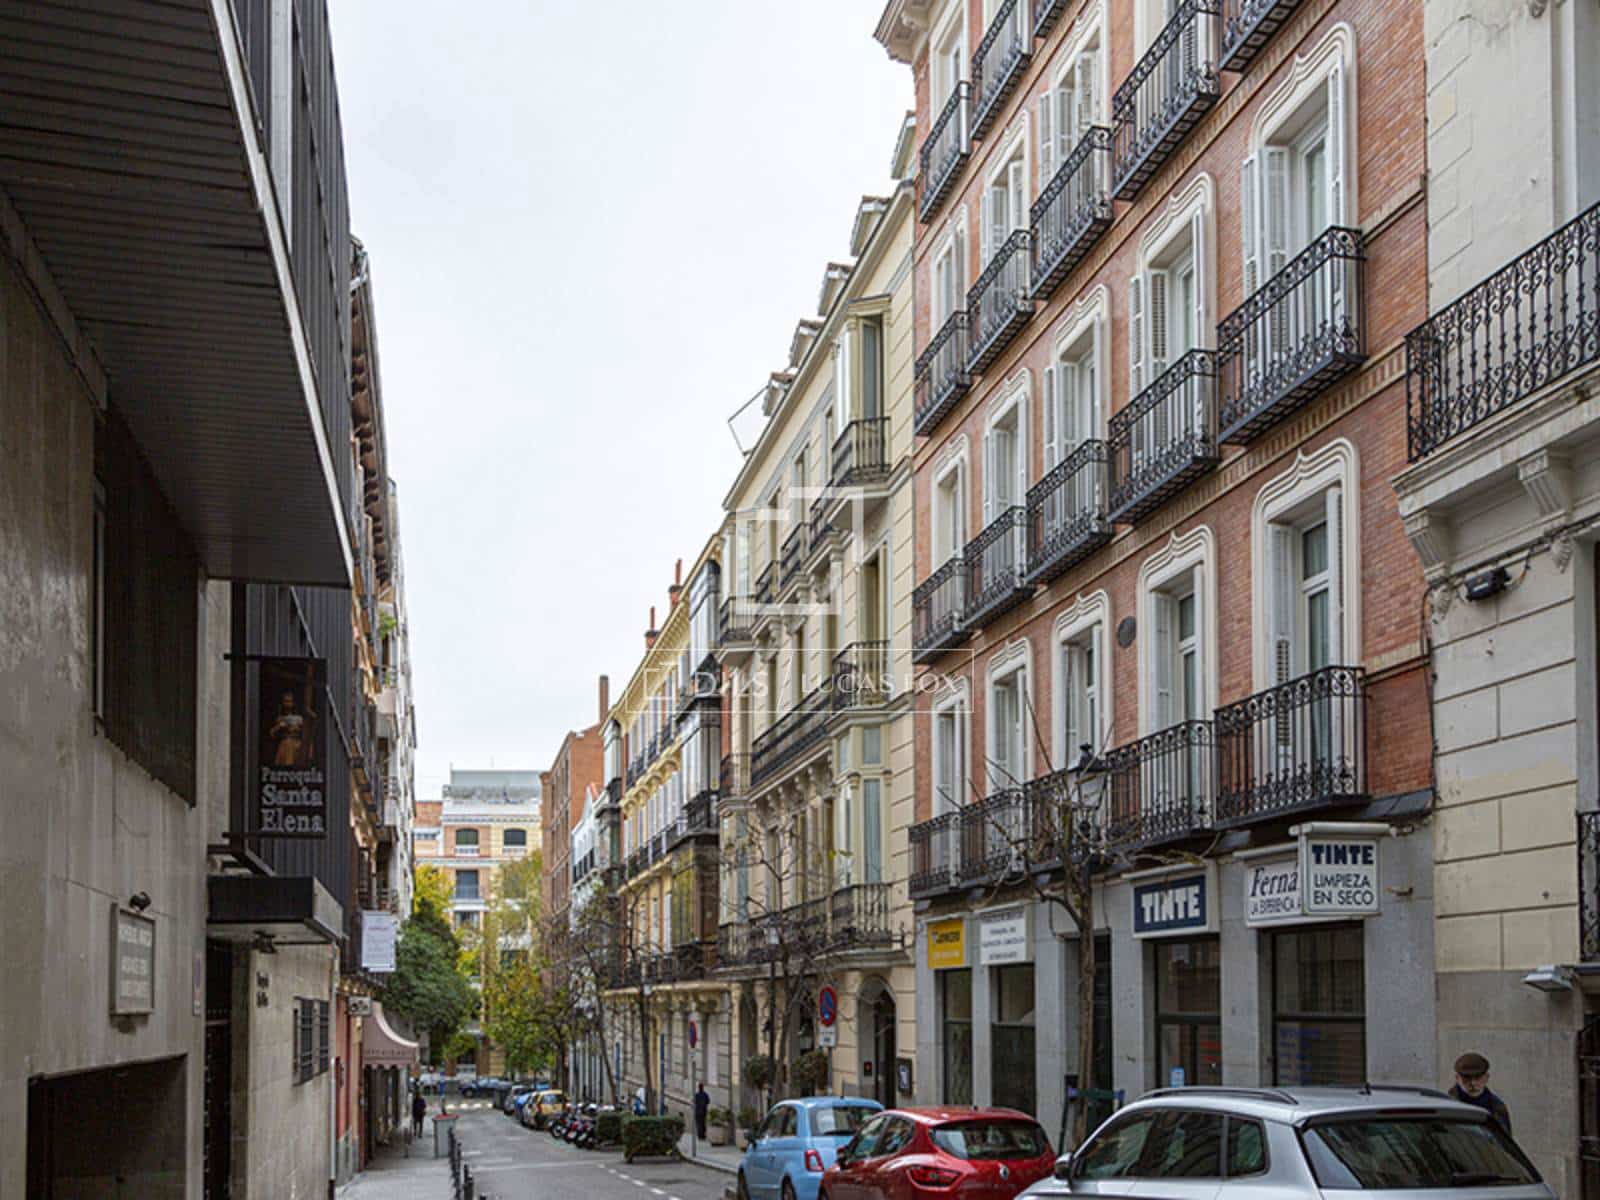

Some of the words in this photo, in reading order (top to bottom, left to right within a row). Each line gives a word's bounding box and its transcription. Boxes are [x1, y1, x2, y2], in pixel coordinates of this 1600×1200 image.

[262, 768, 323, 786] Parroquia
[262, 784, 324, 806] Santa
[261, 808, 325, 832] Elena
[1312, 844, 1374, 865] TINTE
[1314, 873, 1371, 888] LIMPIEZA
[1141, 885, 1200, 924] TINTE
[1314, 890, 1333, 905] EN
[1337, 889, 1375, 906] SECO
